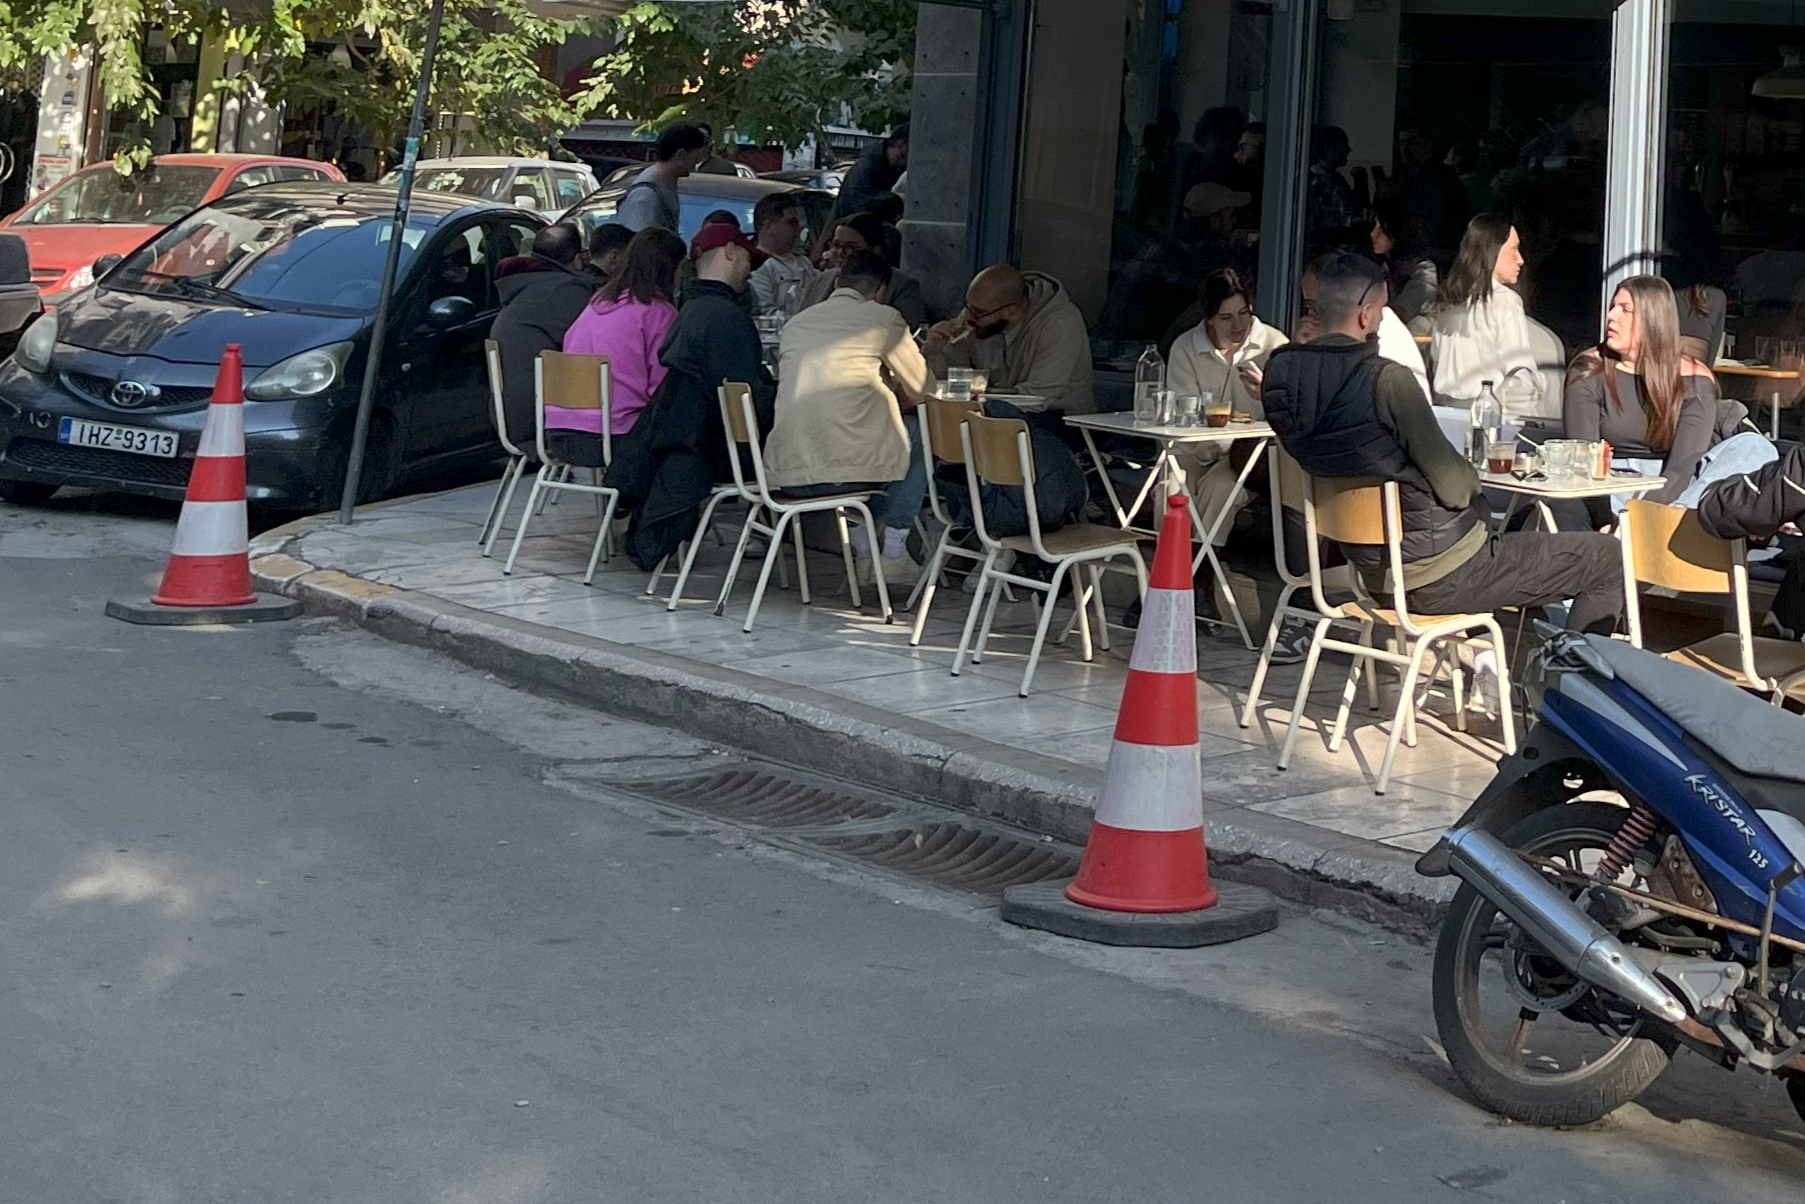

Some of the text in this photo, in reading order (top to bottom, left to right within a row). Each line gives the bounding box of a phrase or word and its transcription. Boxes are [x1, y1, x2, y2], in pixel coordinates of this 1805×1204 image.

[79, 423, 173, 454] IHZ-9313
[1684, 774, 1756, 847] KRISTAR
[1748, 849, 1769, 869] 125
